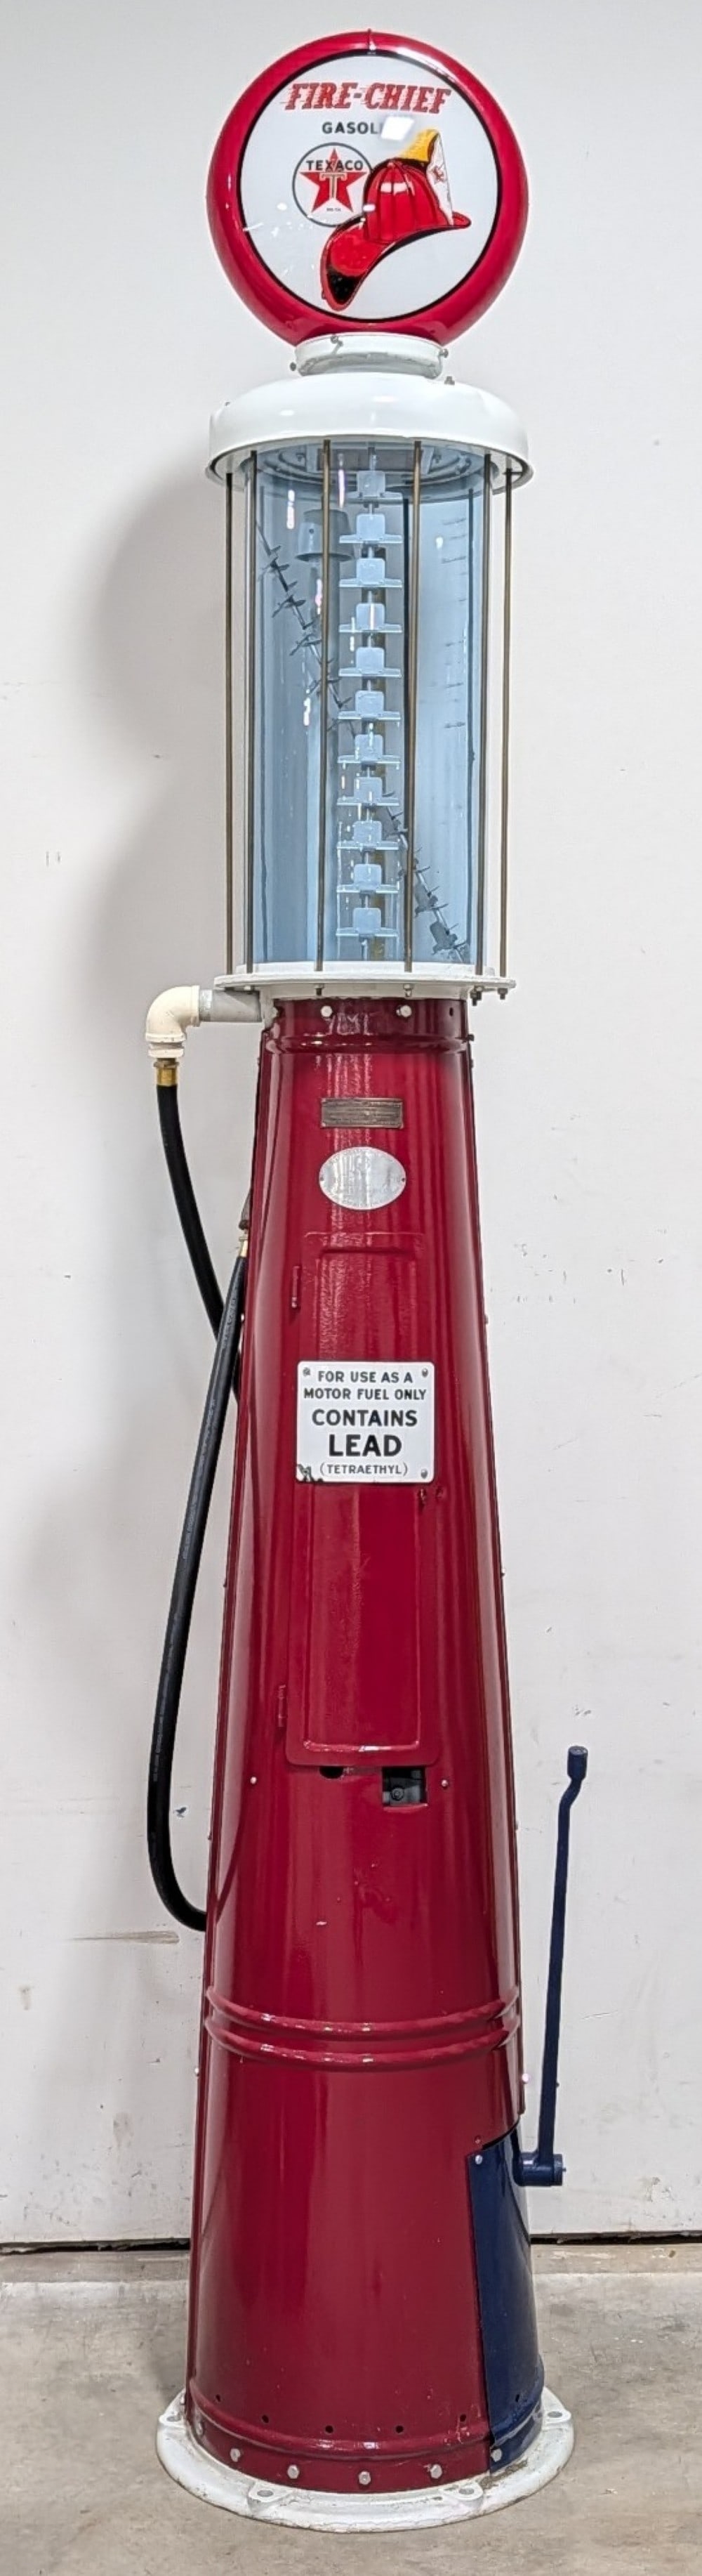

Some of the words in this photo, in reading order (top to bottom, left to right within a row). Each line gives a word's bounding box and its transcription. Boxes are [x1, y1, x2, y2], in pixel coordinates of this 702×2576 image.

[285, 82, 451, 114] FIRE-CHIEF
[322, 122, 384, 135] GASOLI
[306, 159, 364, 171] TEXACO
[318, 1371, 344, 1382] FOR
[350, 1371, 376, 1383] USE
[381, 1372, 399, 1383] AS
[404, 1372, 413, 1383] A
[303, 1388, 351, 1399] MOTOR
[357, 1389, 389, 1400] FUEL
[395, 1389, 427, 1400] ONLY
[312, 1408, 418, 1427] CONTAINS
[329, 1434, 402, 1457] LEAD
[320, 1462, 408, 1477] (TETRAETHYL)
